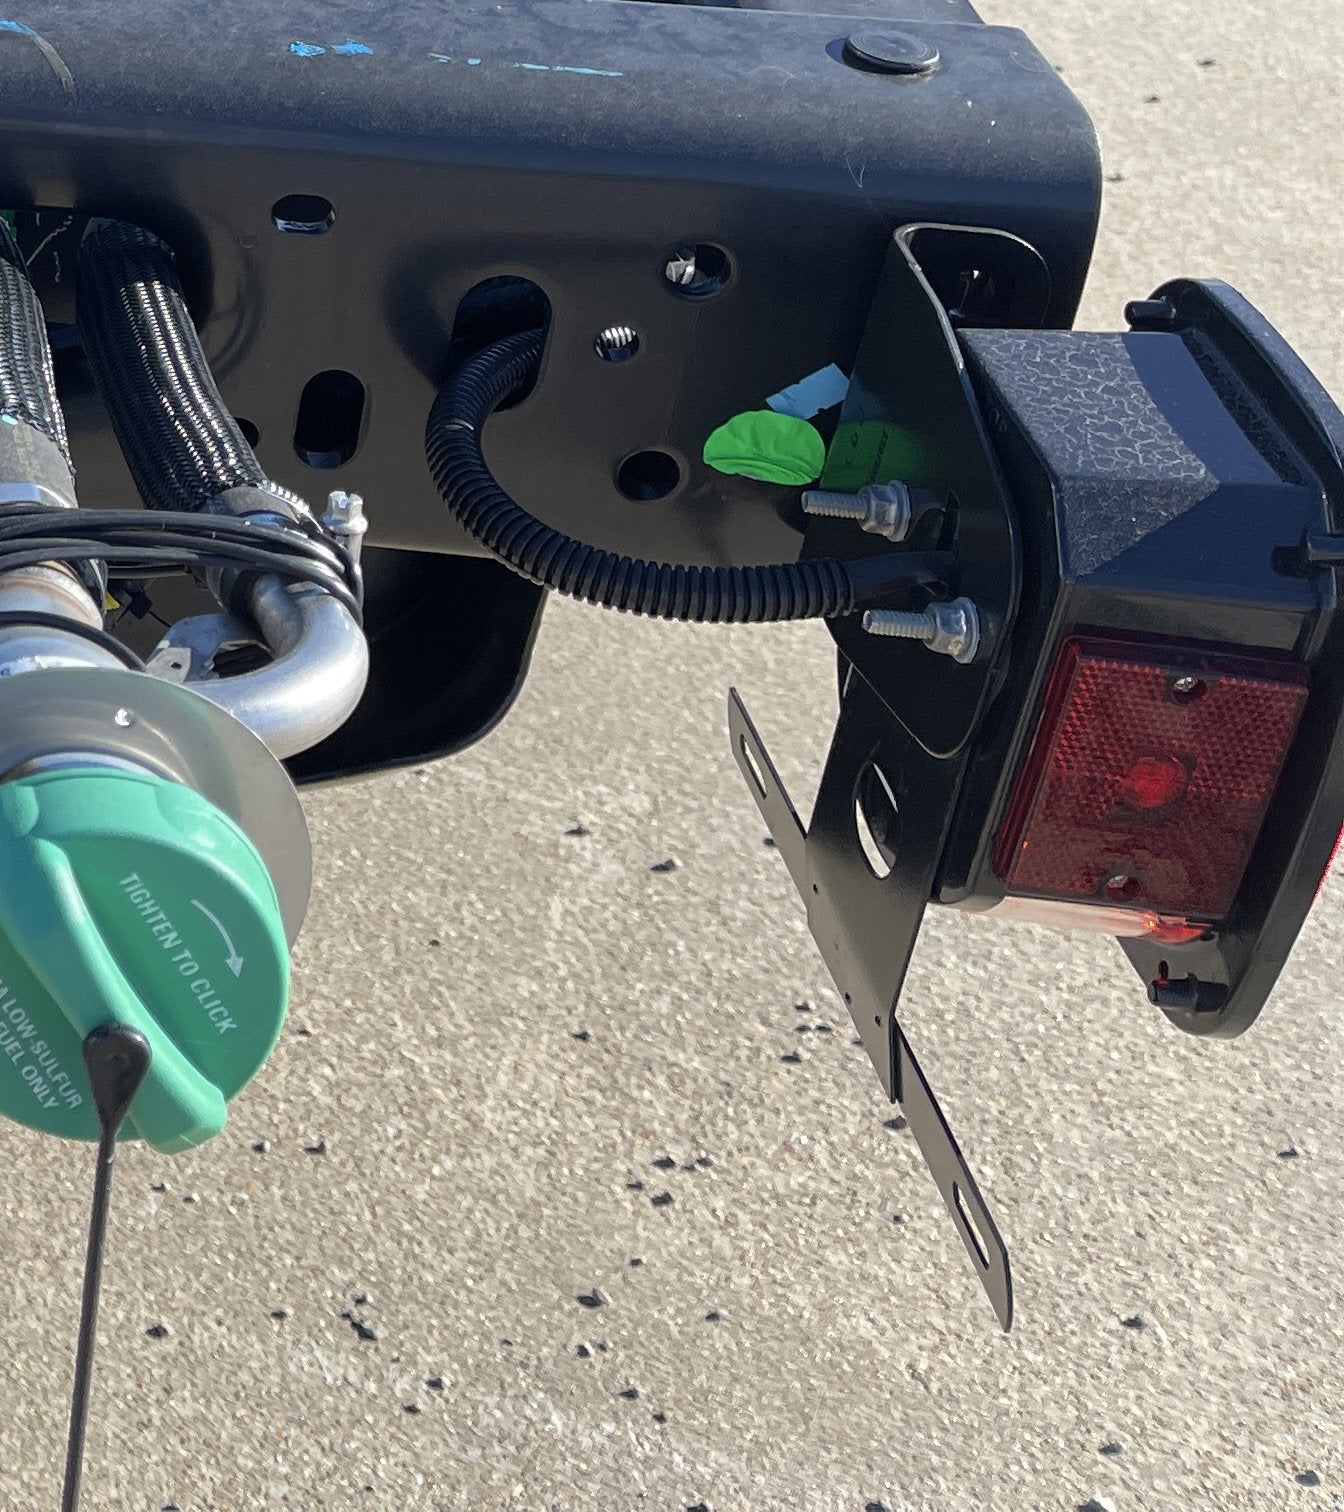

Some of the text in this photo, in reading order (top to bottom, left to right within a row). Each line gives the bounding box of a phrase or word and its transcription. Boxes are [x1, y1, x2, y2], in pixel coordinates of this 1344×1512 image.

[119, 871, 238, 1034] TIGHTEN TO CLICK
[2, 998, 83, 1110] LOW-SULFUR
[21, 1064, 60, 1110] ONLY
